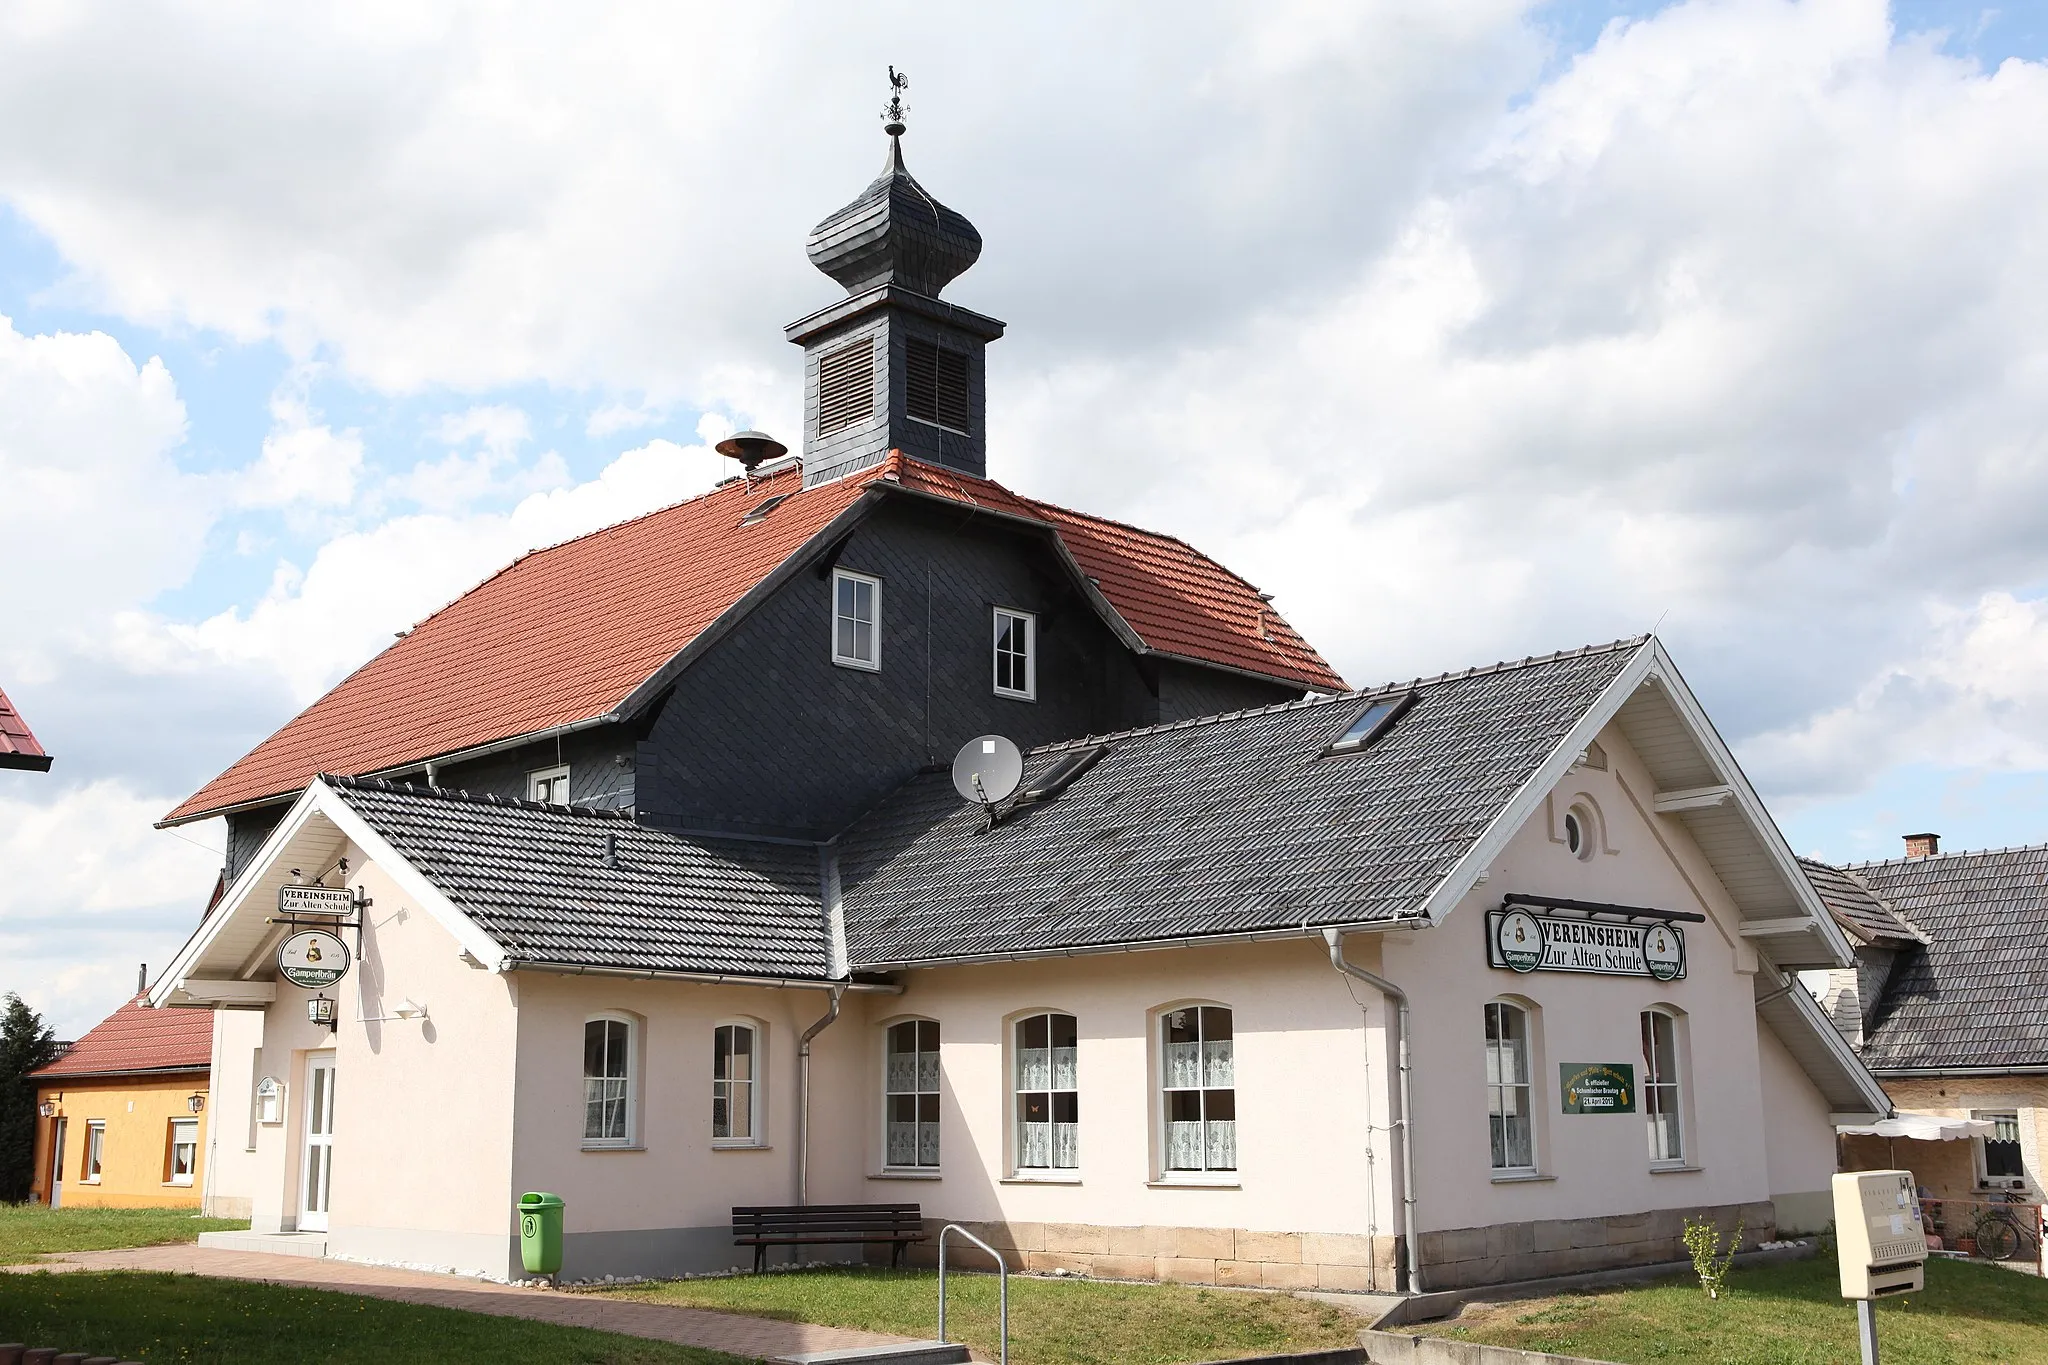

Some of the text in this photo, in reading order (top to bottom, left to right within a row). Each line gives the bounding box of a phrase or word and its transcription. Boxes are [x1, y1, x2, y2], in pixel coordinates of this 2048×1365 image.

[283, 899, 349, 911] Zur Alten Schule
[284, 890, 350, 901] VEREINSHEIM
[1542, 922, 1640, 948] VEREINSHEIM
[1544, 945, 1641, 971] Zur Alten Schule
